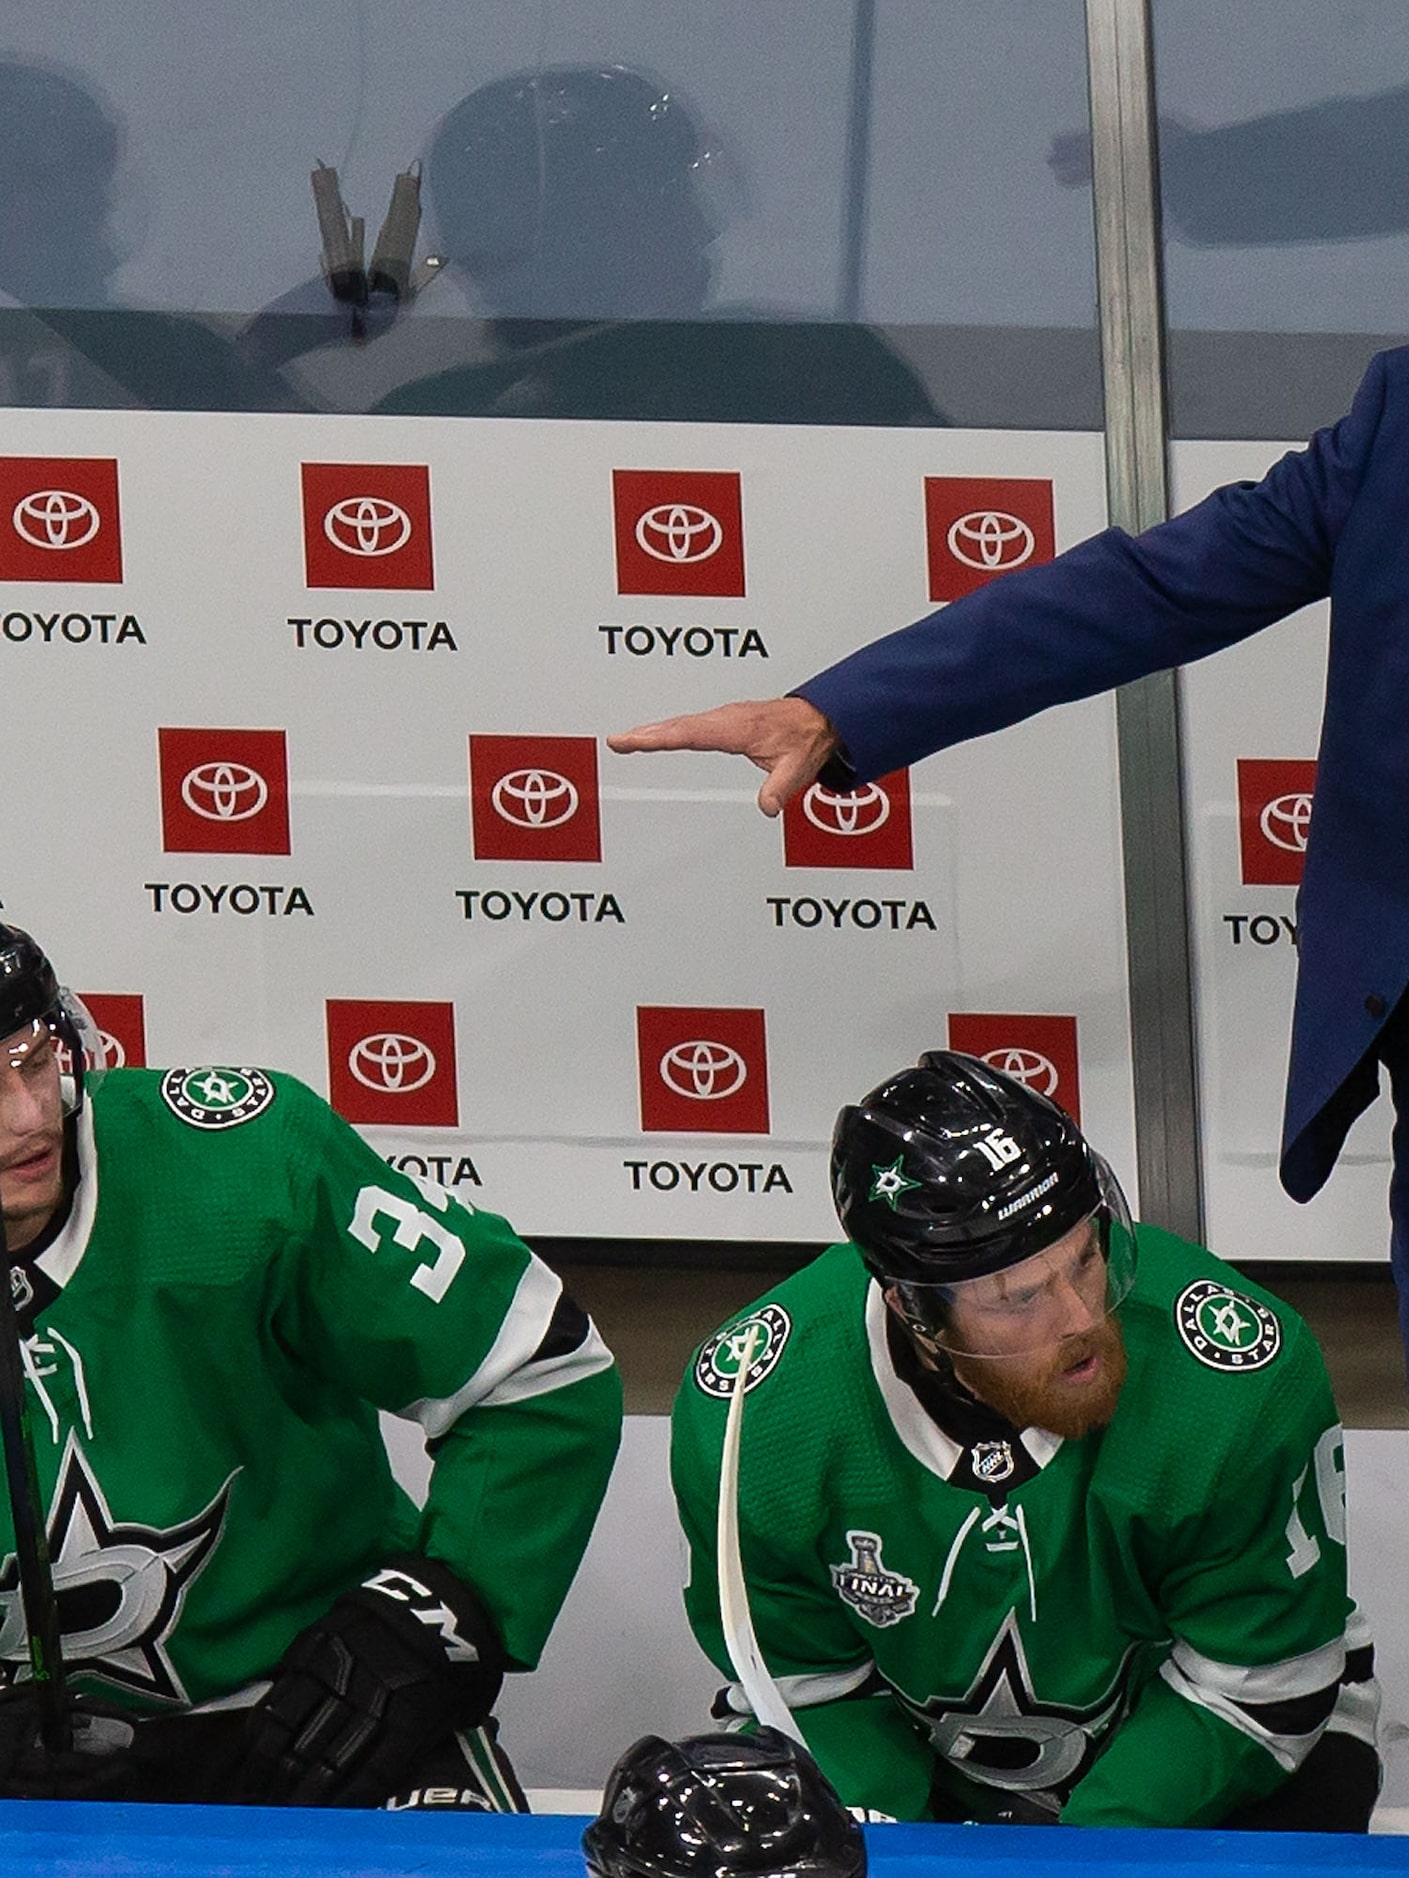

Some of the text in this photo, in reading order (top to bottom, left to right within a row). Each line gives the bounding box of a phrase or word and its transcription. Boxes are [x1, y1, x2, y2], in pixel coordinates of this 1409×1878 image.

[0, 611, 147, 645] OYOTA
[287, 618, 458, 651] TOYOTA
[598, 625, 769, 658] TOYOTA
[144, 883, 315, 916] TOYOTA
[455, 890, 625, 923] TOYOTA
[766, 897, 937, 931] TOYOTA
[1223, 915, 1299, 945] TOY
[972, 1128, 1022, 1172] 16
[623, 1161, 793, 1194] TOYOTA
[1231, 1307, 1275, 1365] STARS
[360, 1568, 481, 1663] CM
[384, 1787, 494, 1813] UER
